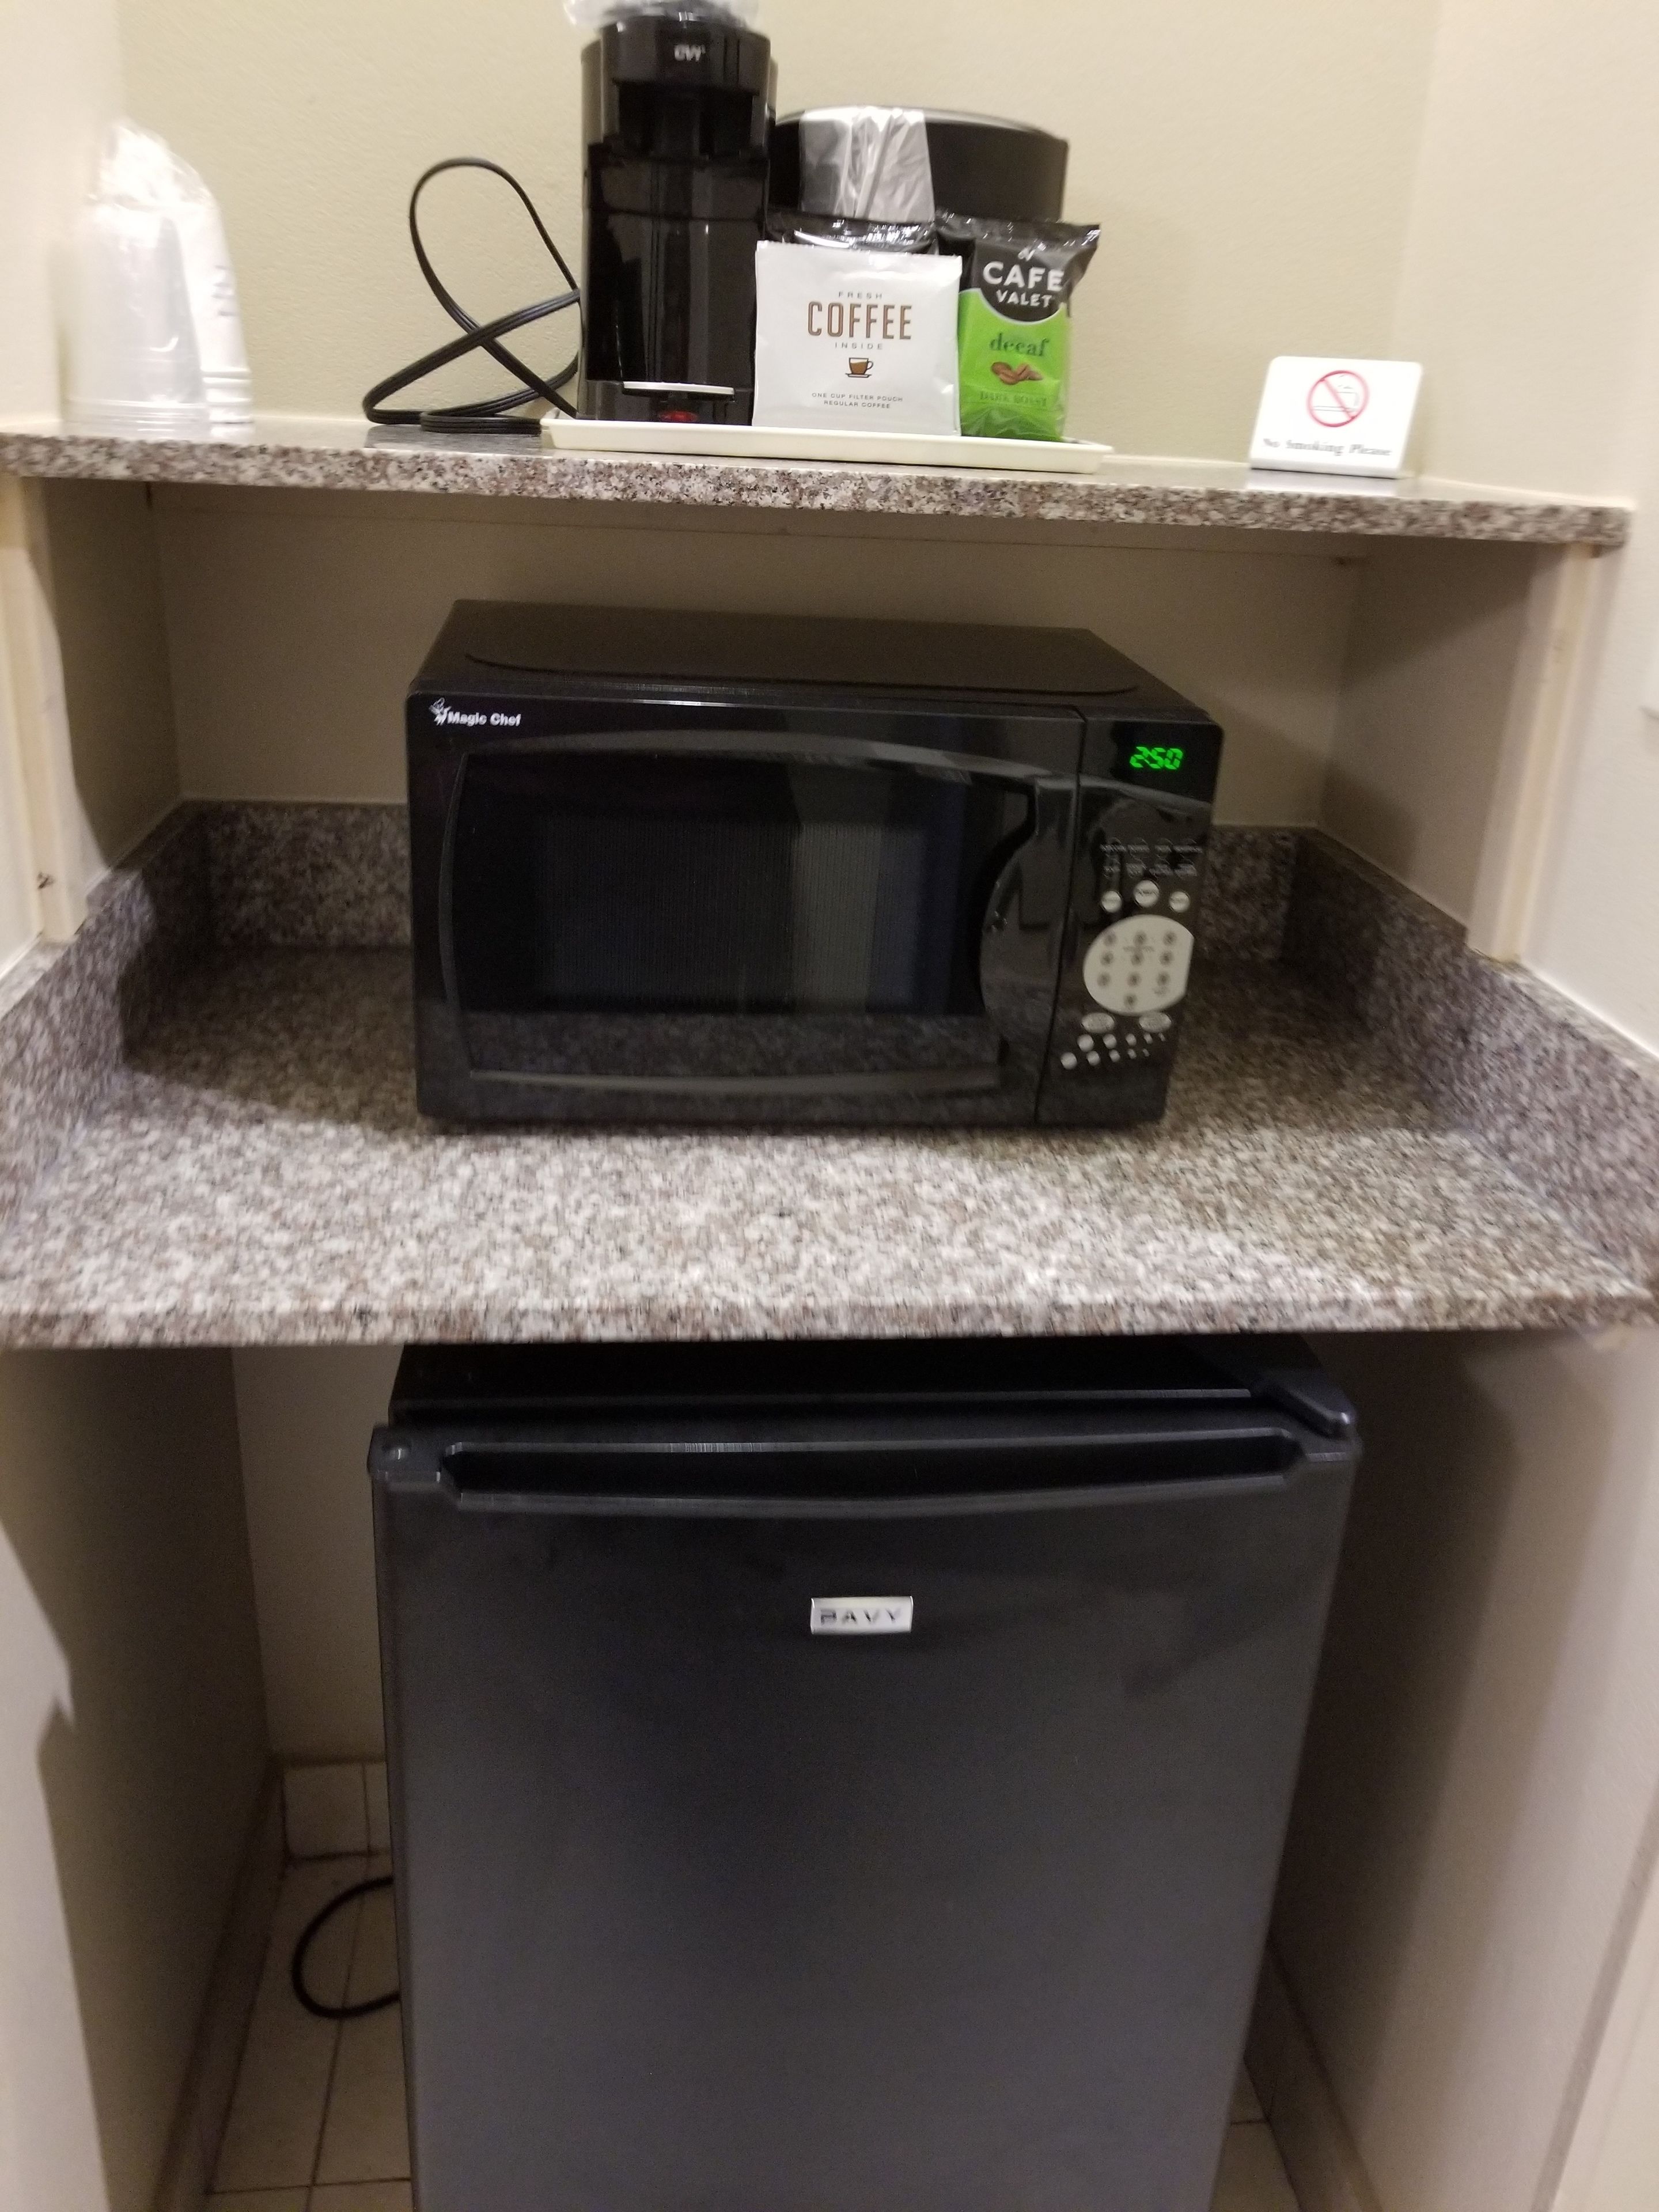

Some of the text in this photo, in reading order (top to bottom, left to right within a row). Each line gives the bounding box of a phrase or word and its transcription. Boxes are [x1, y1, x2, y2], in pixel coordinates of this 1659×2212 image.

[983, 261, 1065, 291] CAFE
[838, 291, 883, 300] FRESH
[996, 289, 1052, 308] VALET
[808, 301, 912, 340] COFFEE
[835, 342, 883, 350] INSIDE
[990, 332, 1050, 357] decaf
[1285, 439, 1344, 456] Smoking
[1349, 444, 1392, 456] Please
[447, 711, 521, 727] Magic Chef
